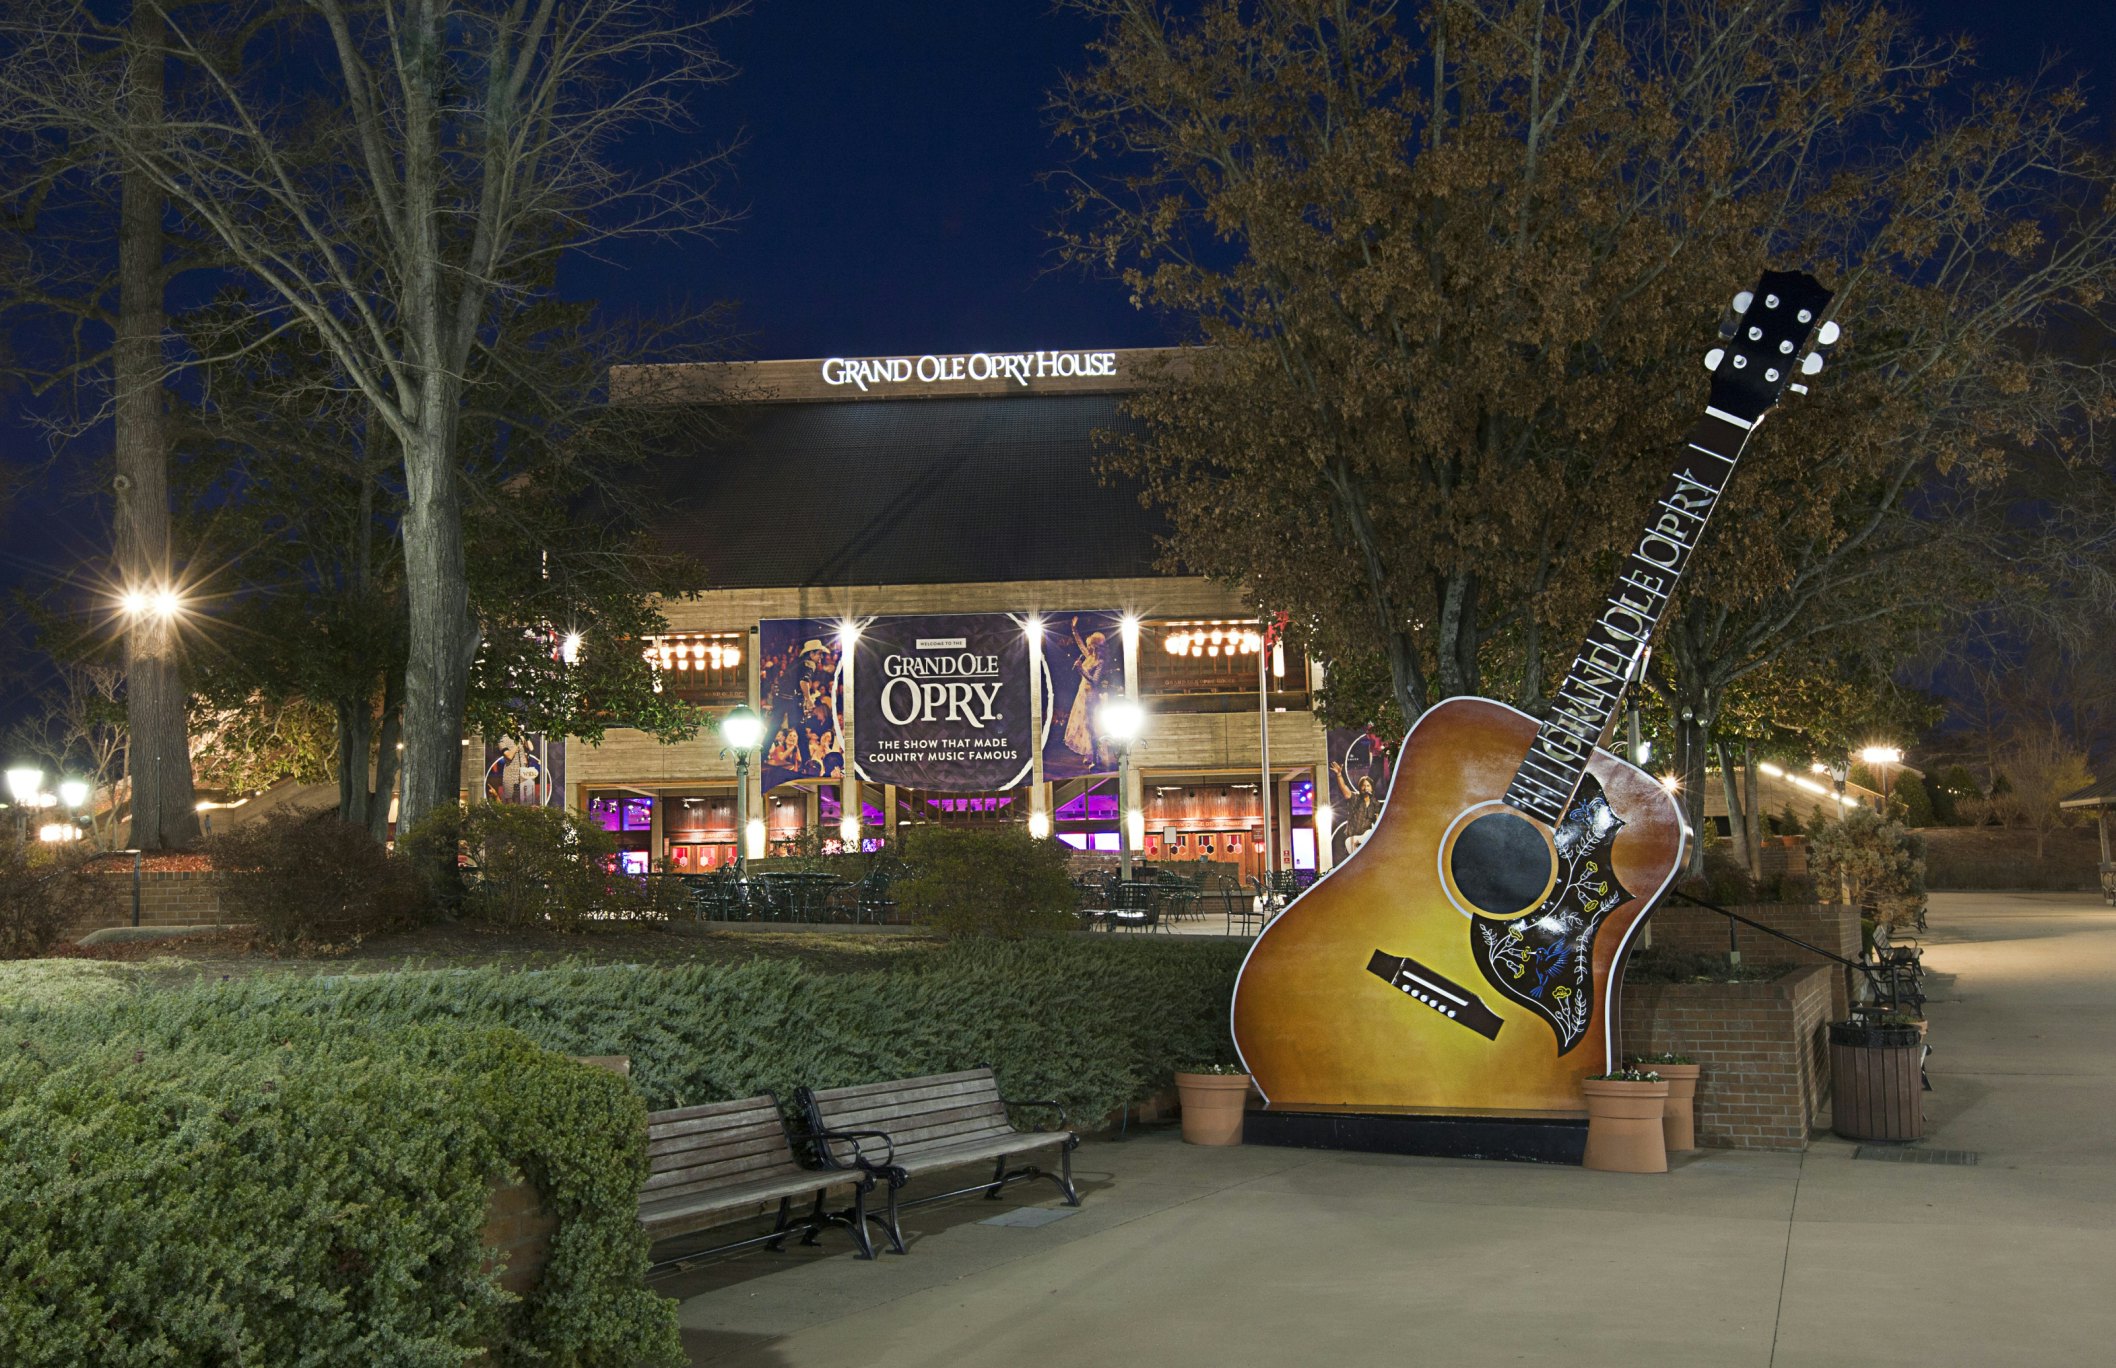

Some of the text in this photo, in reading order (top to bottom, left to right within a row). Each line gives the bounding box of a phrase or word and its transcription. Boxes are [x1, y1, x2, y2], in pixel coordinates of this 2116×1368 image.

[822, 351, 1117, 391] GRAND OLE OPRY HOUSE
[1542, 467, 1715, 762] GRAND OLE OPRY
[884, 652, 999, 678] GRAND OLE
[880, 677, 1003, 728] OPRY
[869, 750, 1018, 763] COUNTRY MUSIC FAMOUS
[878, 738, 1008, 750] THE SHOW THAT MADE
